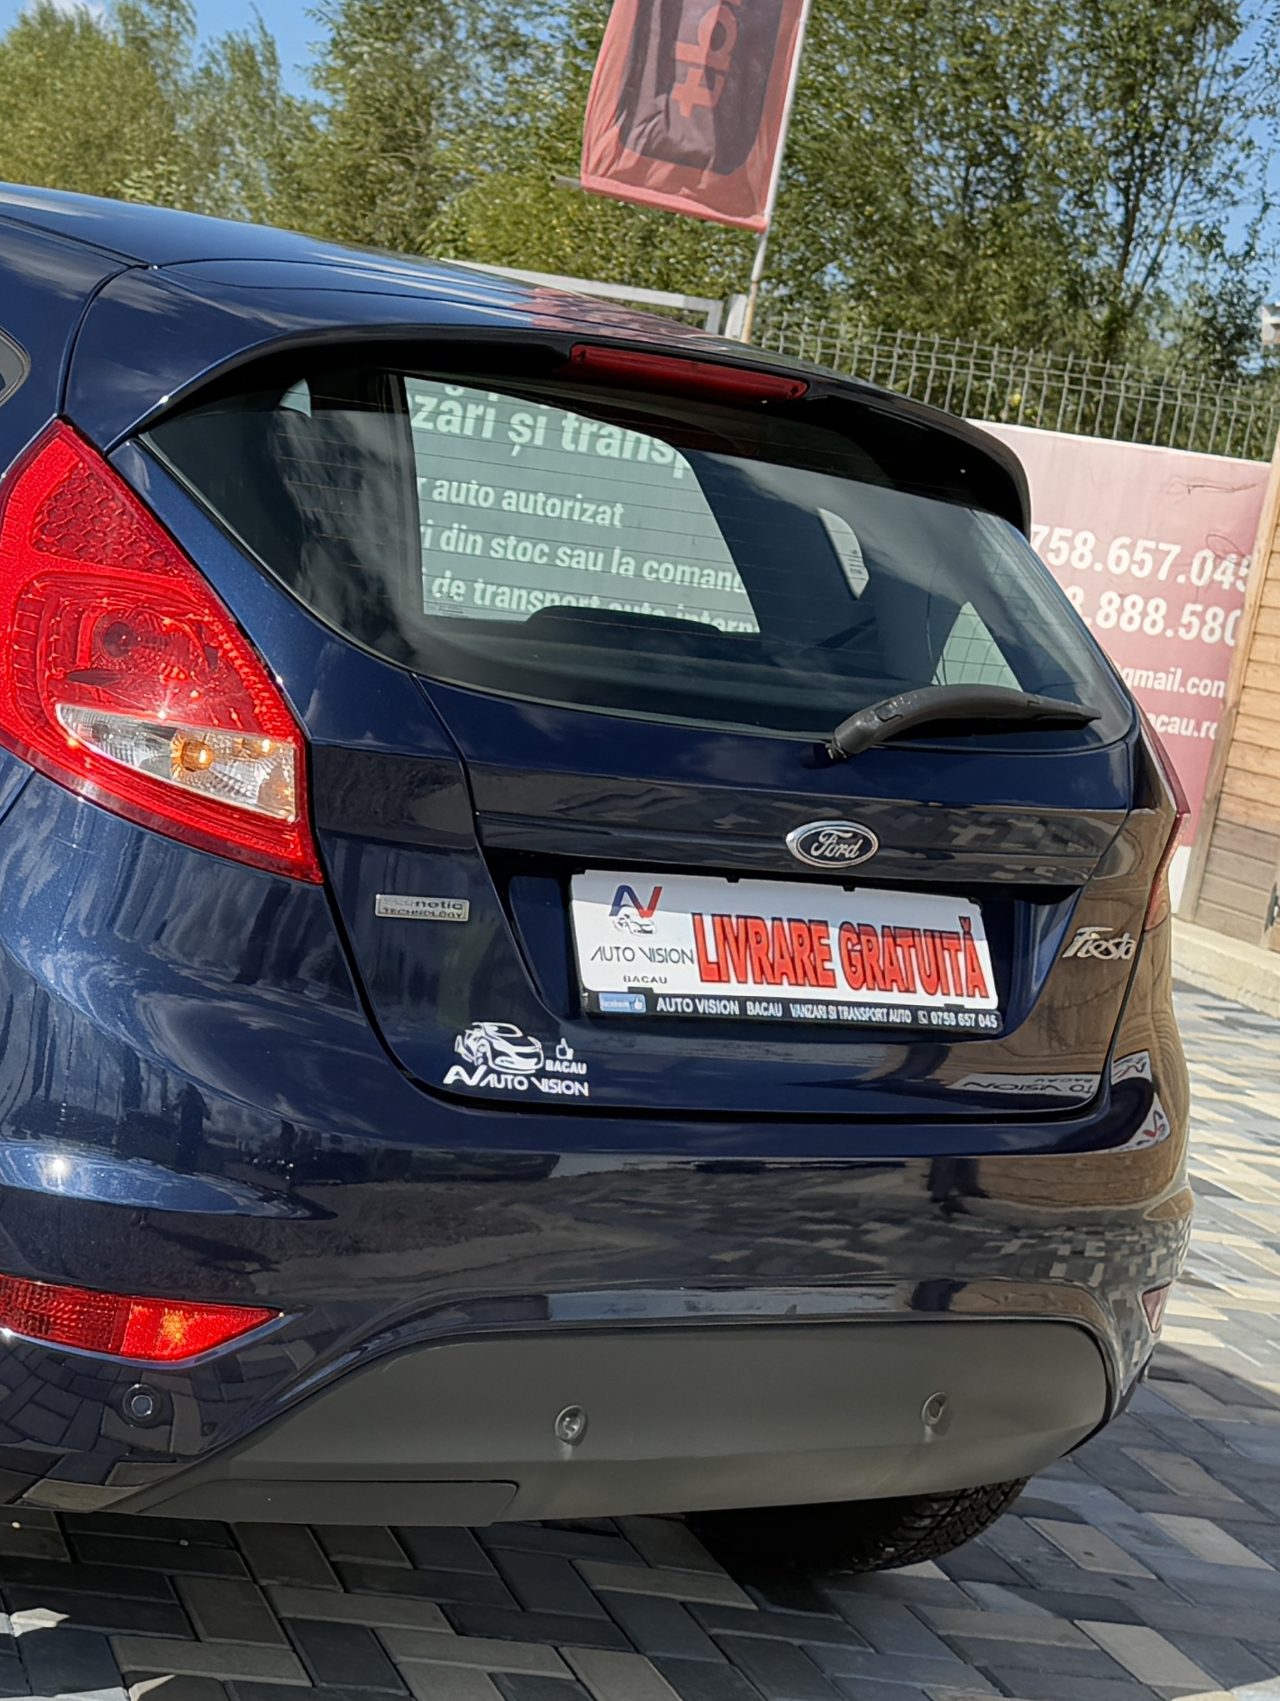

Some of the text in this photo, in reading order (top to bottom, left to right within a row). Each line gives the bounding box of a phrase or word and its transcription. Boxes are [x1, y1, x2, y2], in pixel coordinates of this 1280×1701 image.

[671, 0, 742, 119] tb
[407, 385, 496, 438] zări
[432, 480, 495, 507] auto
[501, 492, 625, 528] autorizat
[439, 523, 483, 555] din
[489, 536, 550, 565] stoc
[555, 545, 604, 572] sau
[611, 546, 636, 578] la
[432, 570, 466, 602] de
[1117, 663, 1226, 699] gmail.com
[810, 829, 863, 859] Ford
[590, 945, 695, 965] AUTO VISION
[691, 912, 990, 998] LIVRARE GRATUITĂ
[1062, 926, 1136, 960] Fiesta
[623, 974, 668, 985] BACAU
[656, 997, 693, 1013] AUTO
[695, 998, 739, 1015] VISION
[746, 1001, 783, 1017] BACAU
[838, 1005, 888, 1022] TRANSPORT
[889, 1008, 912, 1023] AUTO
[957, 1012, 976, 1027] 657
[978, 1013, 998, 1029] 045
[545, 1059, 588, 1075] BACAU
[480, 1073, 529, 1091] AUTO
[530, 1076, 590, 1097] VISION
